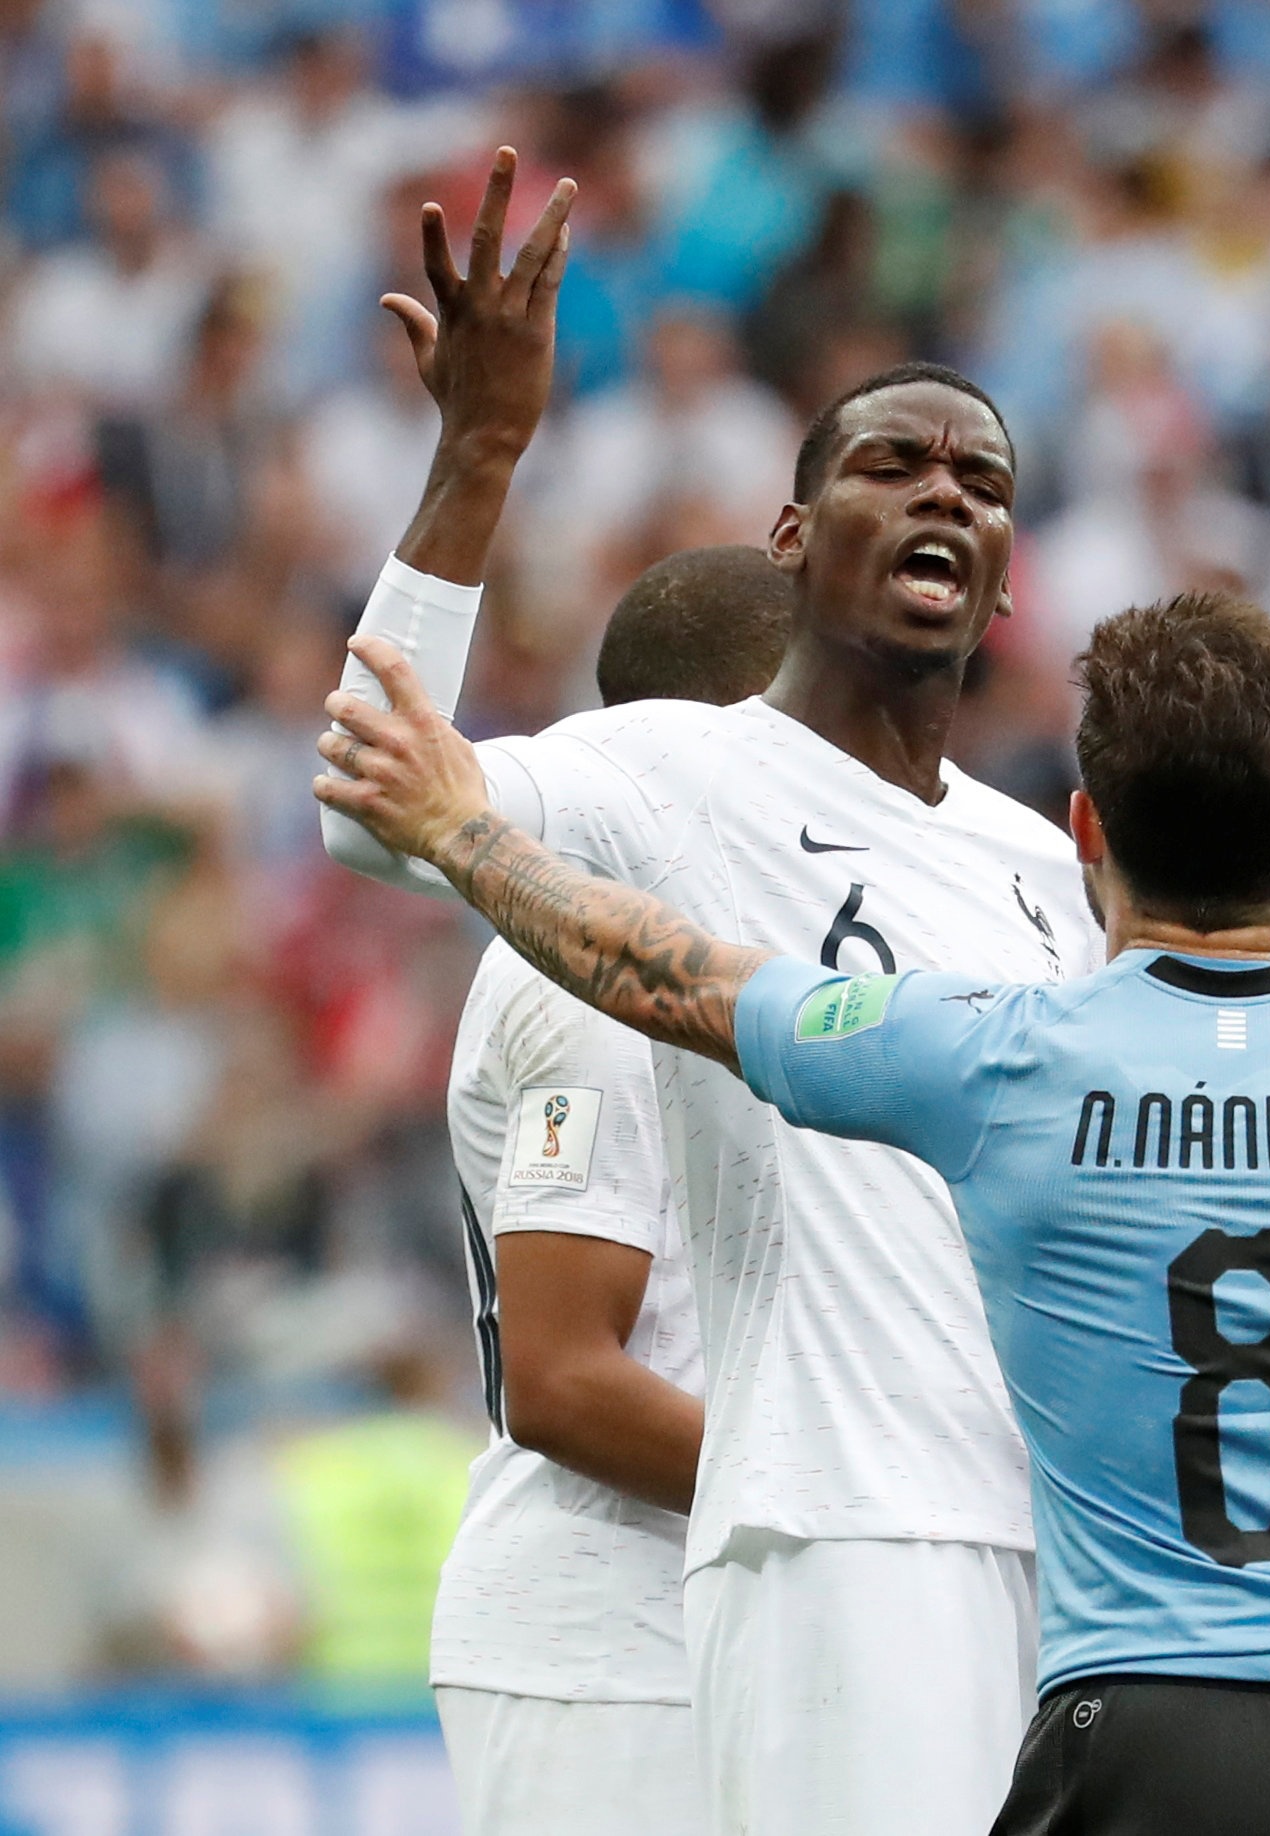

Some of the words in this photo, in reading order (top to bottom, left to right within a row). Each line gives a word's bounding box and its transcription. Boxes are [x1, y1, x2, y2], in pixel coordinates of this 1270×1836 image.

[820, 882, 897, 975] 6
[823, 1003, 837, 1032] FIFA
[514, 1169, 554, 1180] RUSSIA
[556, 1170, 584, 1184] 2018
